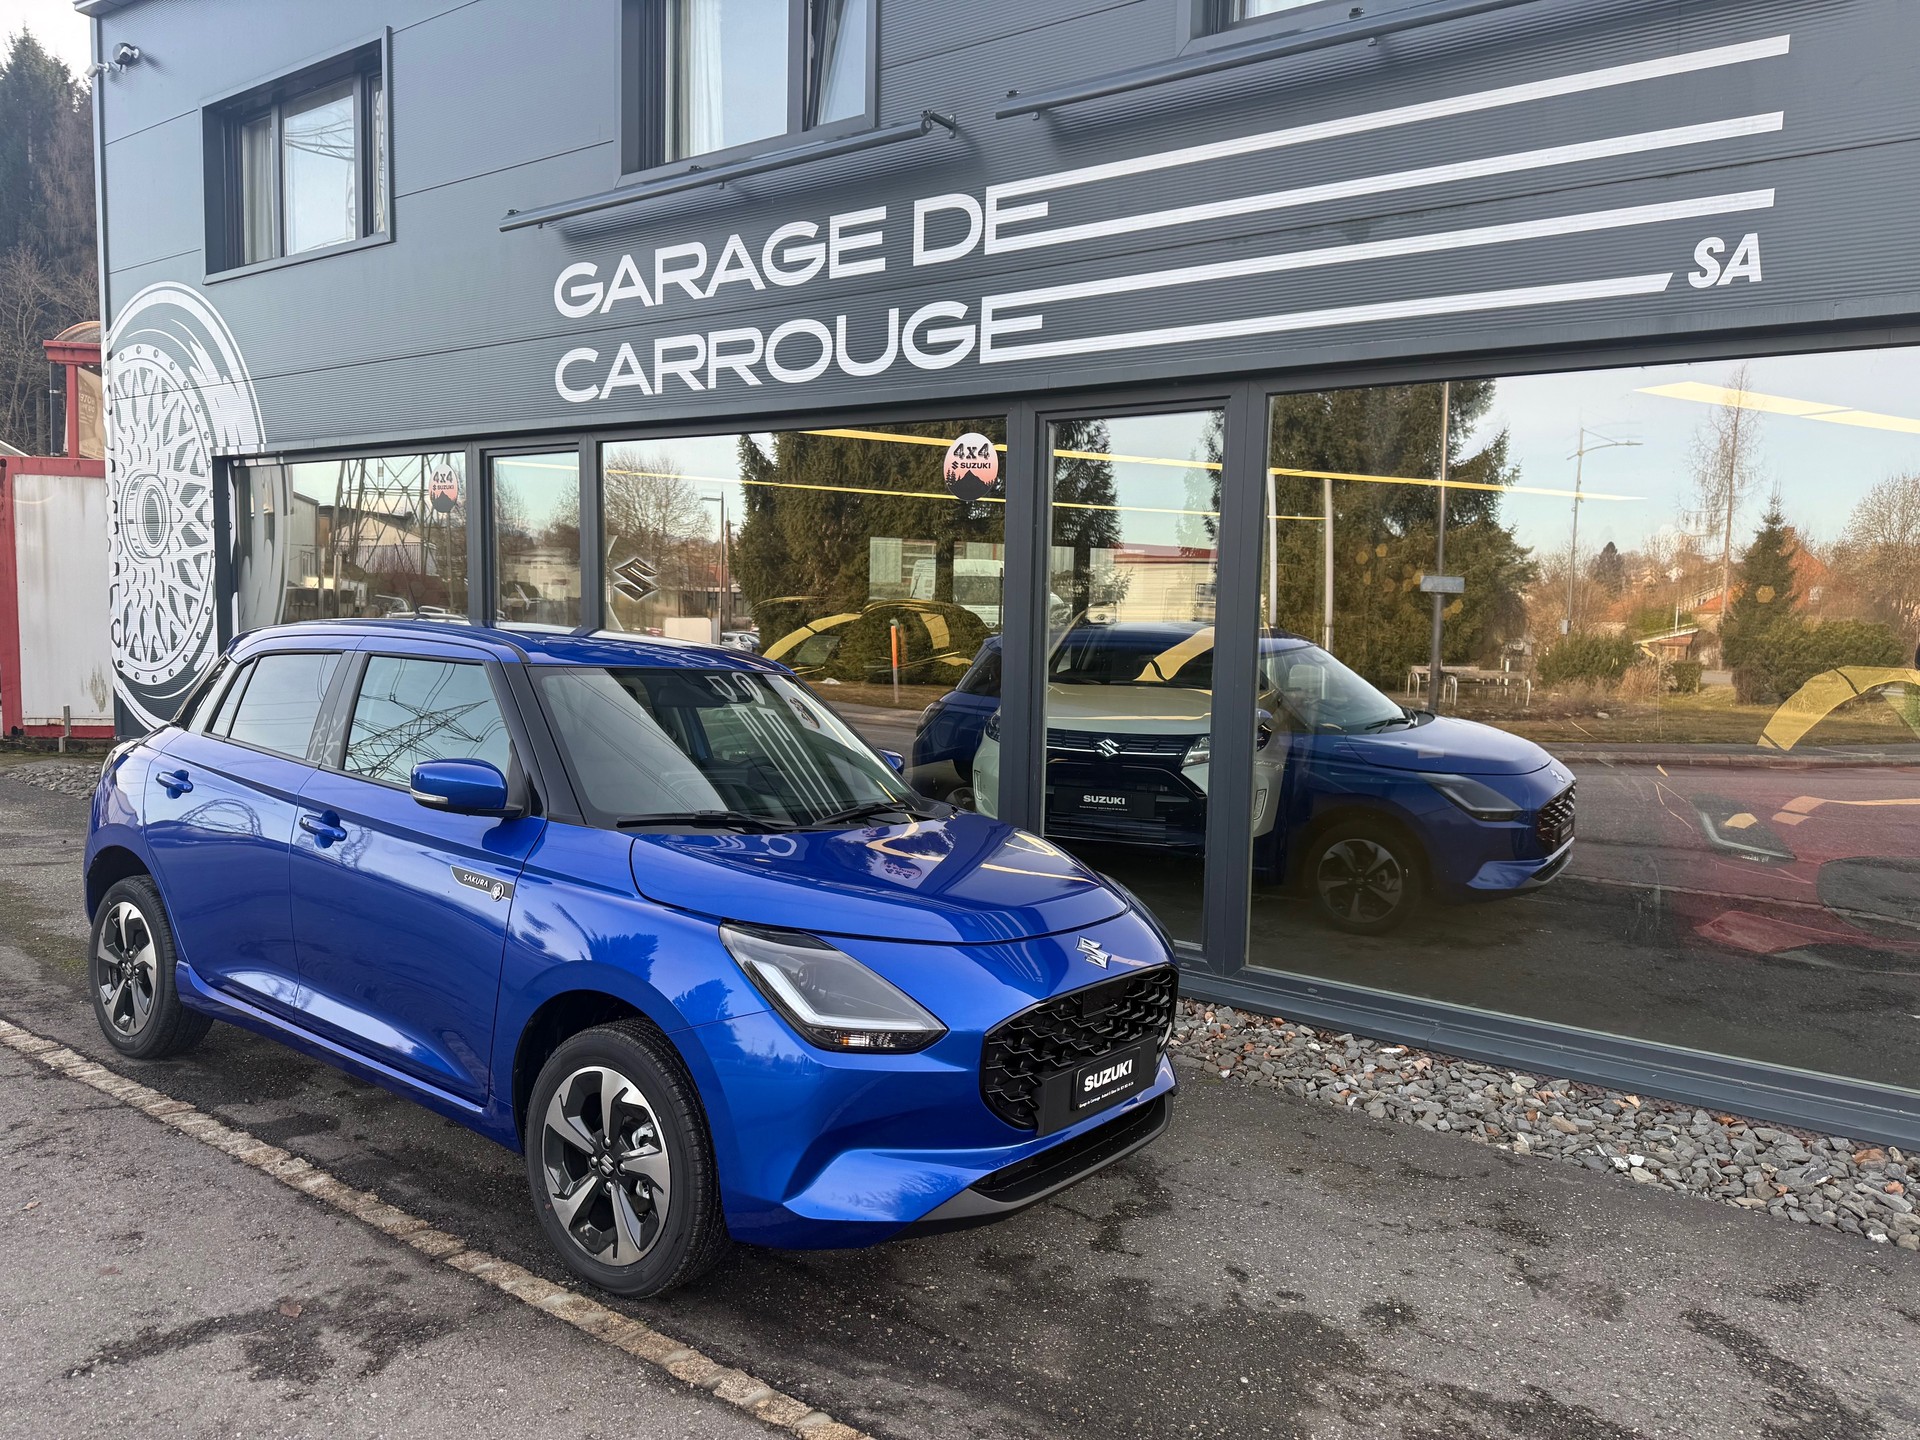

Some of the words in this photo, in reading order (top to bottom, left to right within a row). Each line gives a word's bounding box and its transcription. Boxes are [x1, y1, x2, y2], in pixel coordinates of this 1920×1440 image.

[553, 205, 887, 318] GARAGE
[912, 184, 1050, 268] DE
[1687, 232, 1763, 289] SA
[553, 293, 1044, 402] CARROUGE
[953, 443, 990, 460] 4x4
[433, 471, 453, 483] 4x4
[1083, 794, 1126, 805] SUZUKI
[463, 873, 489, 888] SAKURA
[1083, 1058, 1133, 1092] SUZUKI
